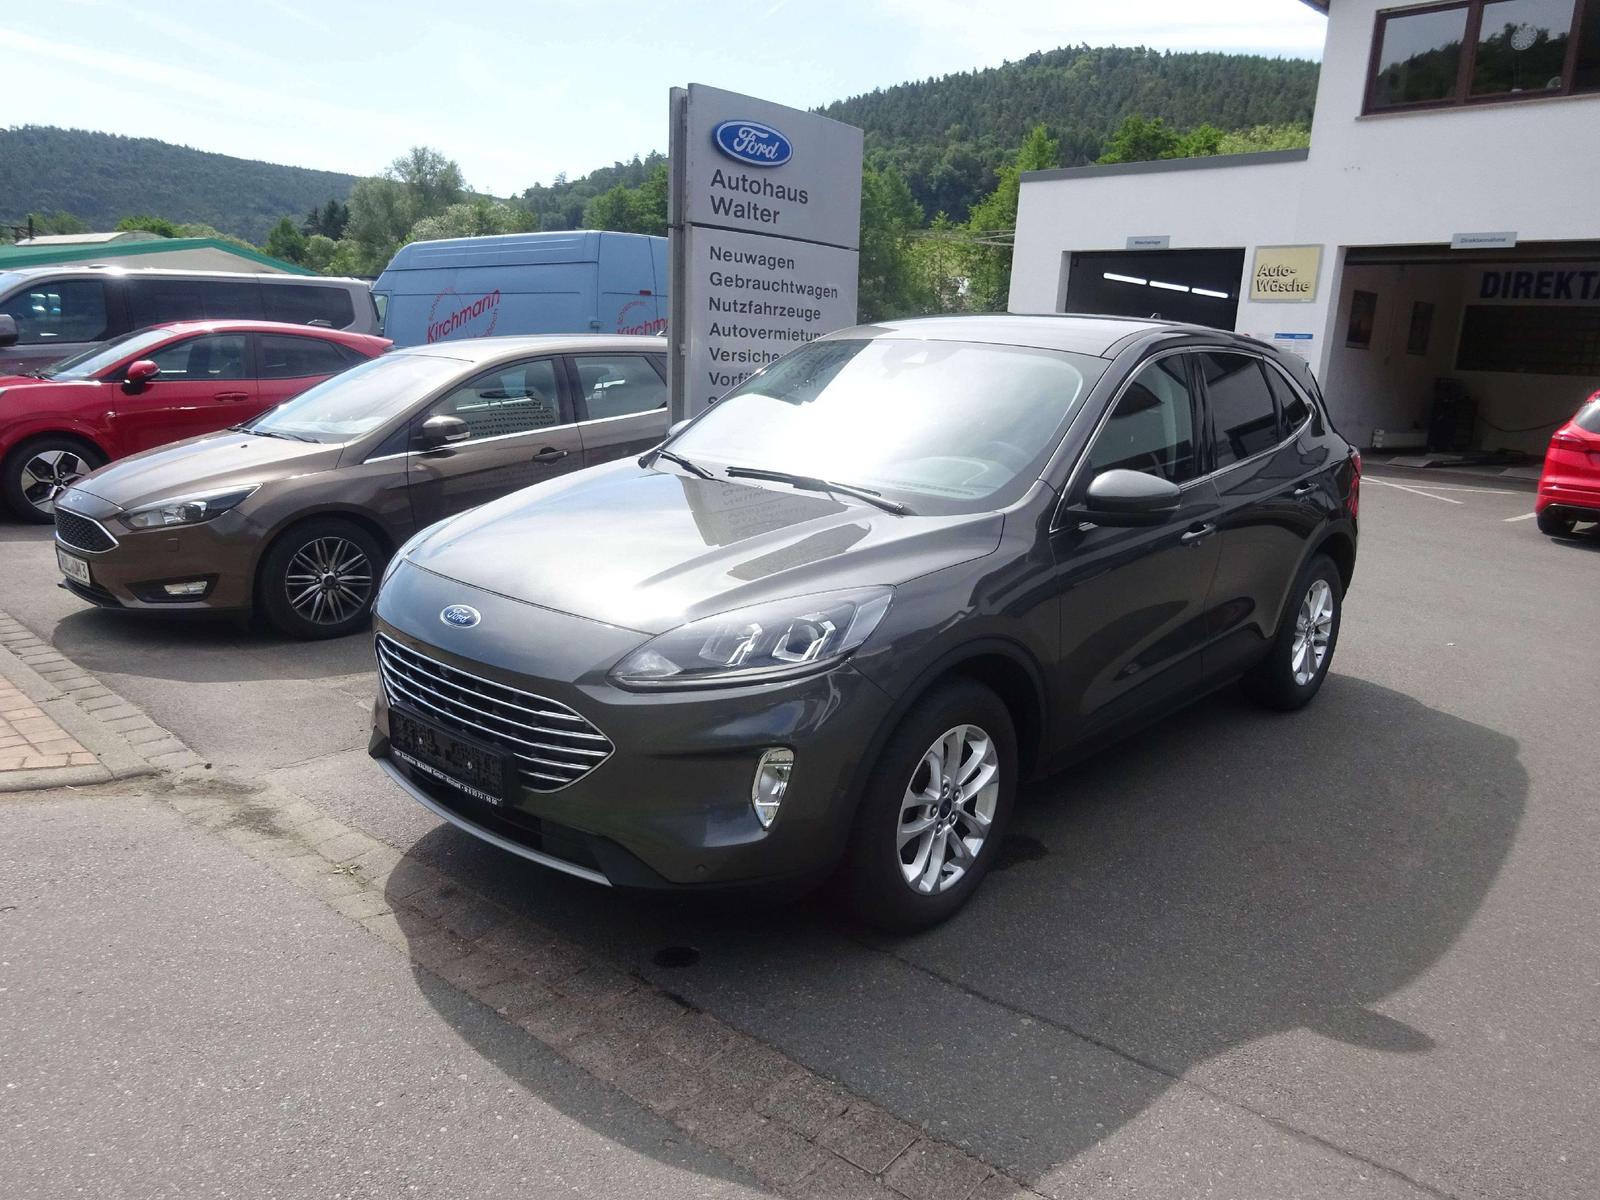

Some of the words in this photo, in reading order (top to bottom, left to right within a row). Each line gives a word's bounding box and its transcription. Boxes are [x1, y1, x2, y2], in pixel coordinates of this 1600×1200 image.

[710, 169, 808, 204] Autohaus
[710, 196, 780, 224] Walter
[709, 246, 795, 270] Neuwagen
[1257, 264, 1296, 278] Auto-
[709, 272, 838, 300] Gebrauchtwagen
[1256, 278, 1311, 293] Wäsche
[427, 288, 501, 344] Kirchmann
[709, 298, 820, 321] Nutzfahrzeuge
[709, 322, 827, 342] Autovermietun
[708, 347, 783, 363] Versiche
